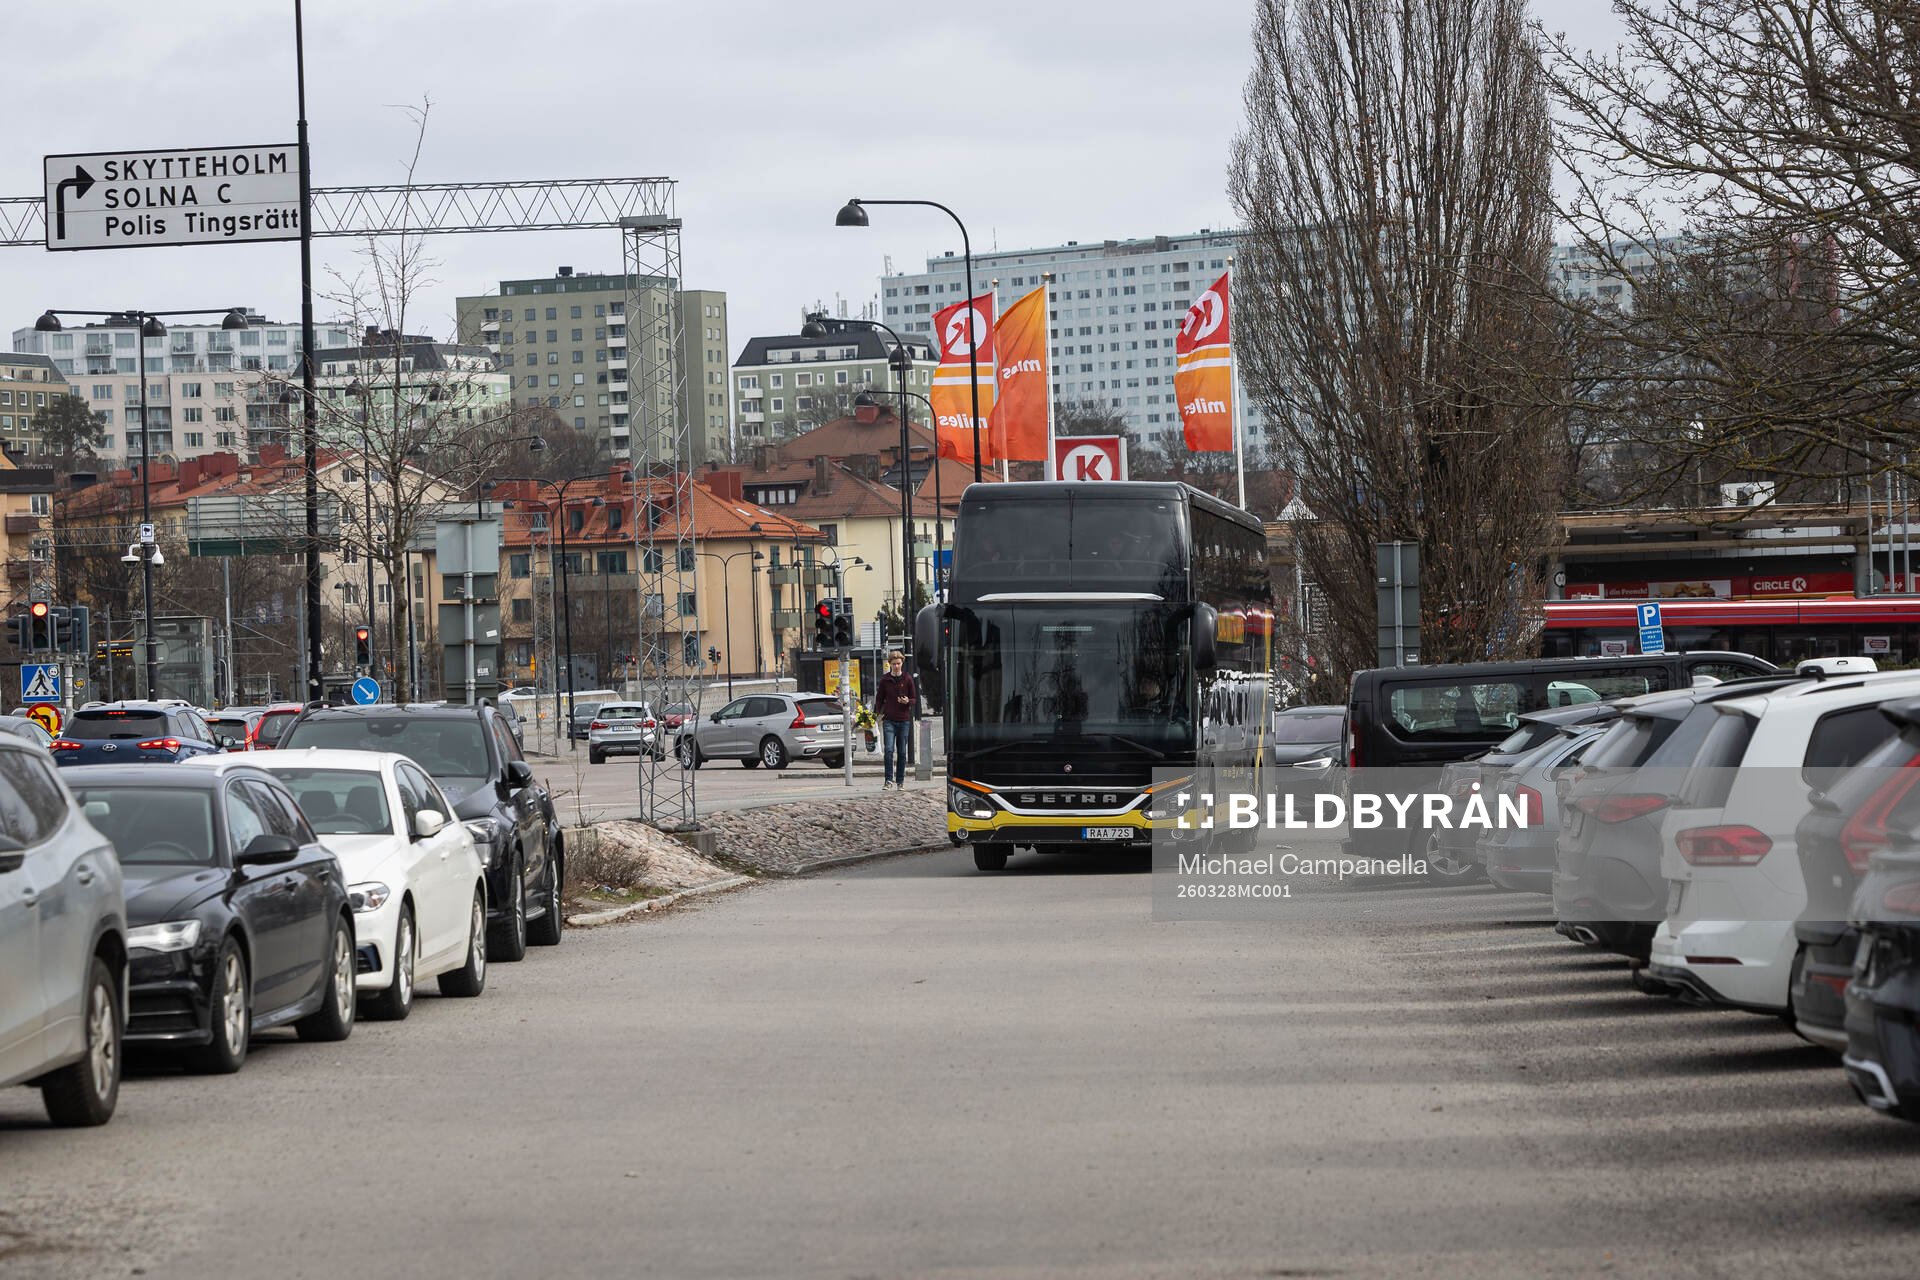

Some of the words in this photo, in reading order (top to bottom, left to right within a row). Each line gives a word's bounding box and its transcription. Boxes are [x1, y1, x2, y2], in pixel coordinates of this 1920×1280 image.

[104, 152, 287, 181] SKYTTEHOLM
[105, 185, 198, 209] SOLNA
[217, 183, 232, 204] C
[105, 214, 166, 237] Polis
[184, 208, 299, 237] Tingsrätt
[1076, 454, 1105, 481] K
[1753, 580, 1790, 592] CIRCLE
[1793, 577, 1806, 592] K
[1643, 605, 1656, 625] P
[1020, 794, 1118, 803] SETRA
[1089, 828, 1109, 838] RAA
[1111, 828, 1130, 838] 72S
